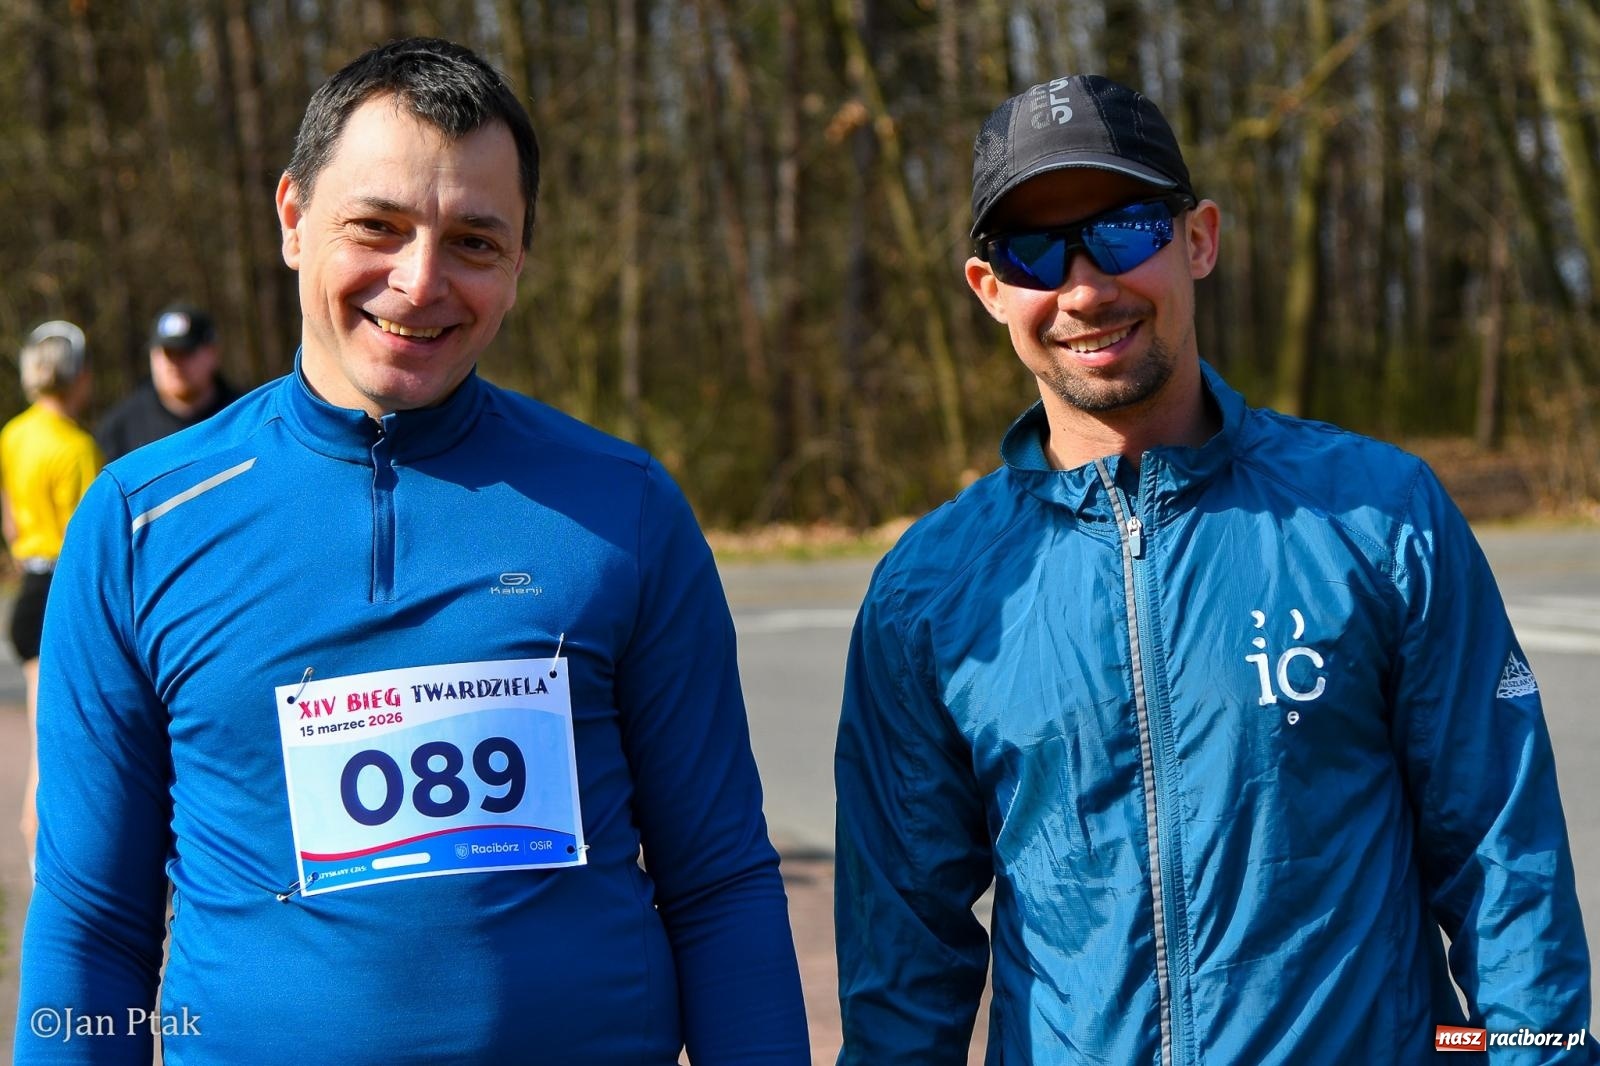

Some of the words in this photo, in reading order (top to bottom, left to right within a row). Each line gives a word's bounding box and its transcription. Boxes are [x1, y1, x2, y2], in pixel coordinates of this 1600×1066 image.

[490, 586, 543, 597] Kalenji
[298, 695, 336, 720] XIV
[347, 687, 401, 713] BIEG
[409, 676, 549, 703] TWARDZIELA
[300, 725, 314, 737] 15
[317, 719, 366, 735] marzec
[368, 712, 403, 727] 2026
[340, 736, 527, 826] 089
[471, 842, 520, 854] Racibórz
